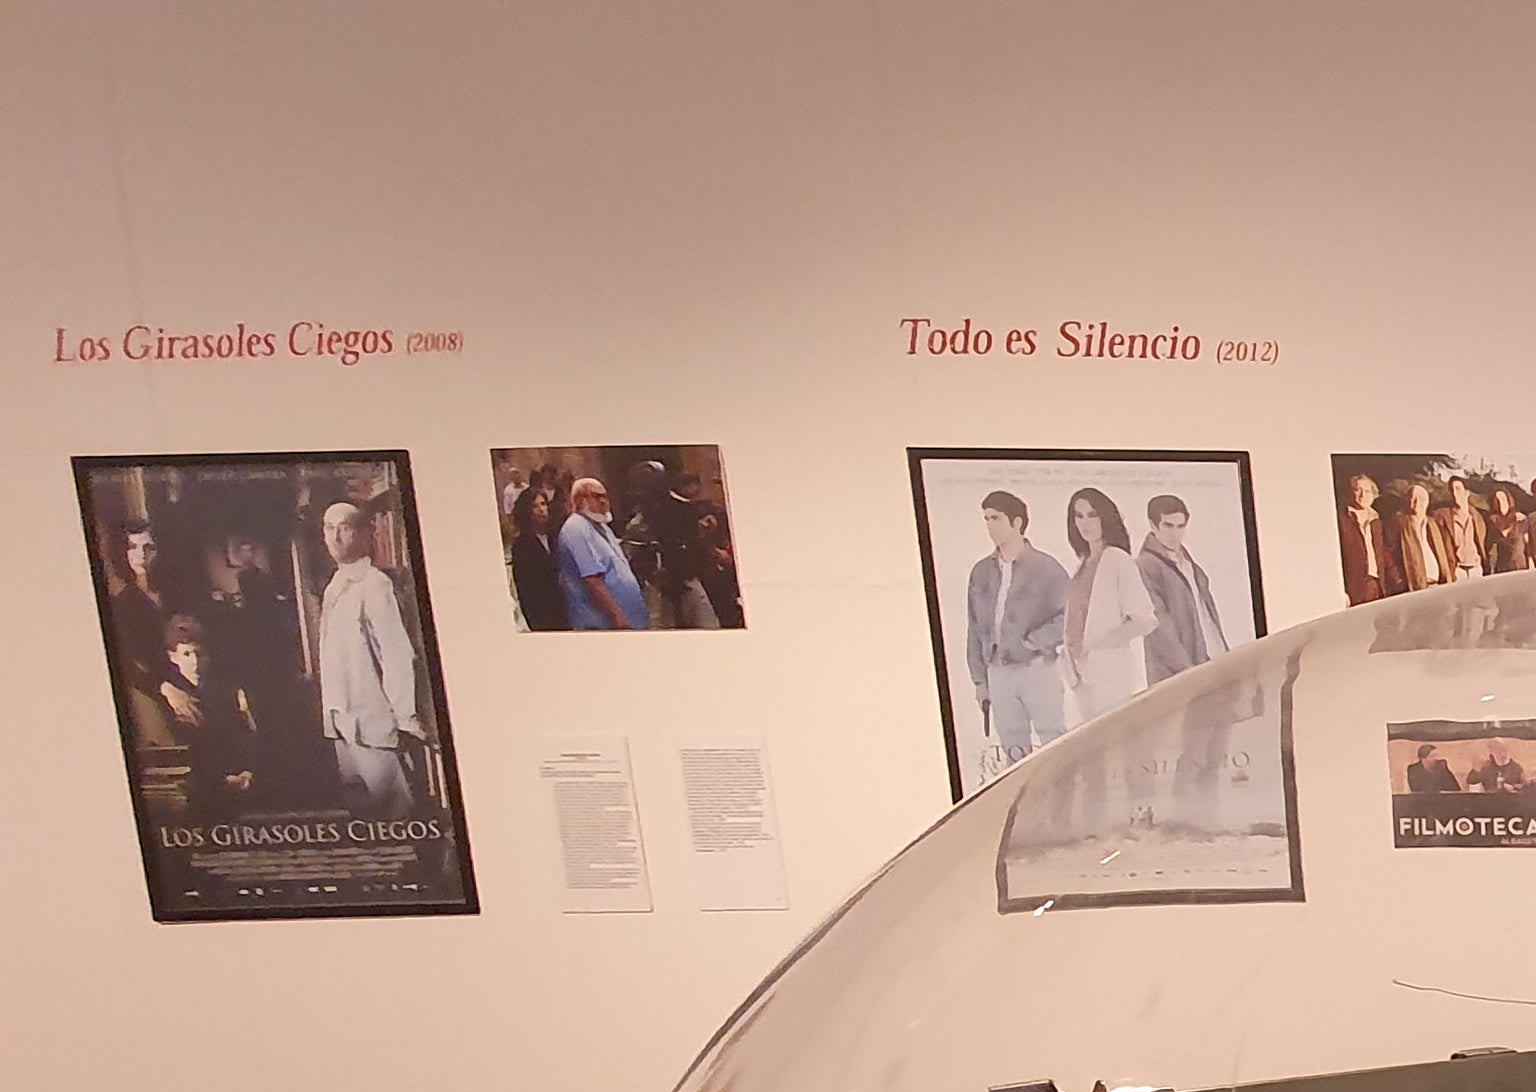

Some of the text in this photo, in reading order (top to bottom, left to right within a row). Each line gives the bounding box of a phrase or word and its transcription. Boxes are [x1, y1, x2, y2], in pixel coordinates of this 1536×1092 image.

[55, 321, 463, 366] Los Girasoles Ciegos (2008)
[900, 318, 1279, 365] Todo es Silencio (2012)
[160, 818, 442, 848] LOS GIRASOLES CIEGOS
